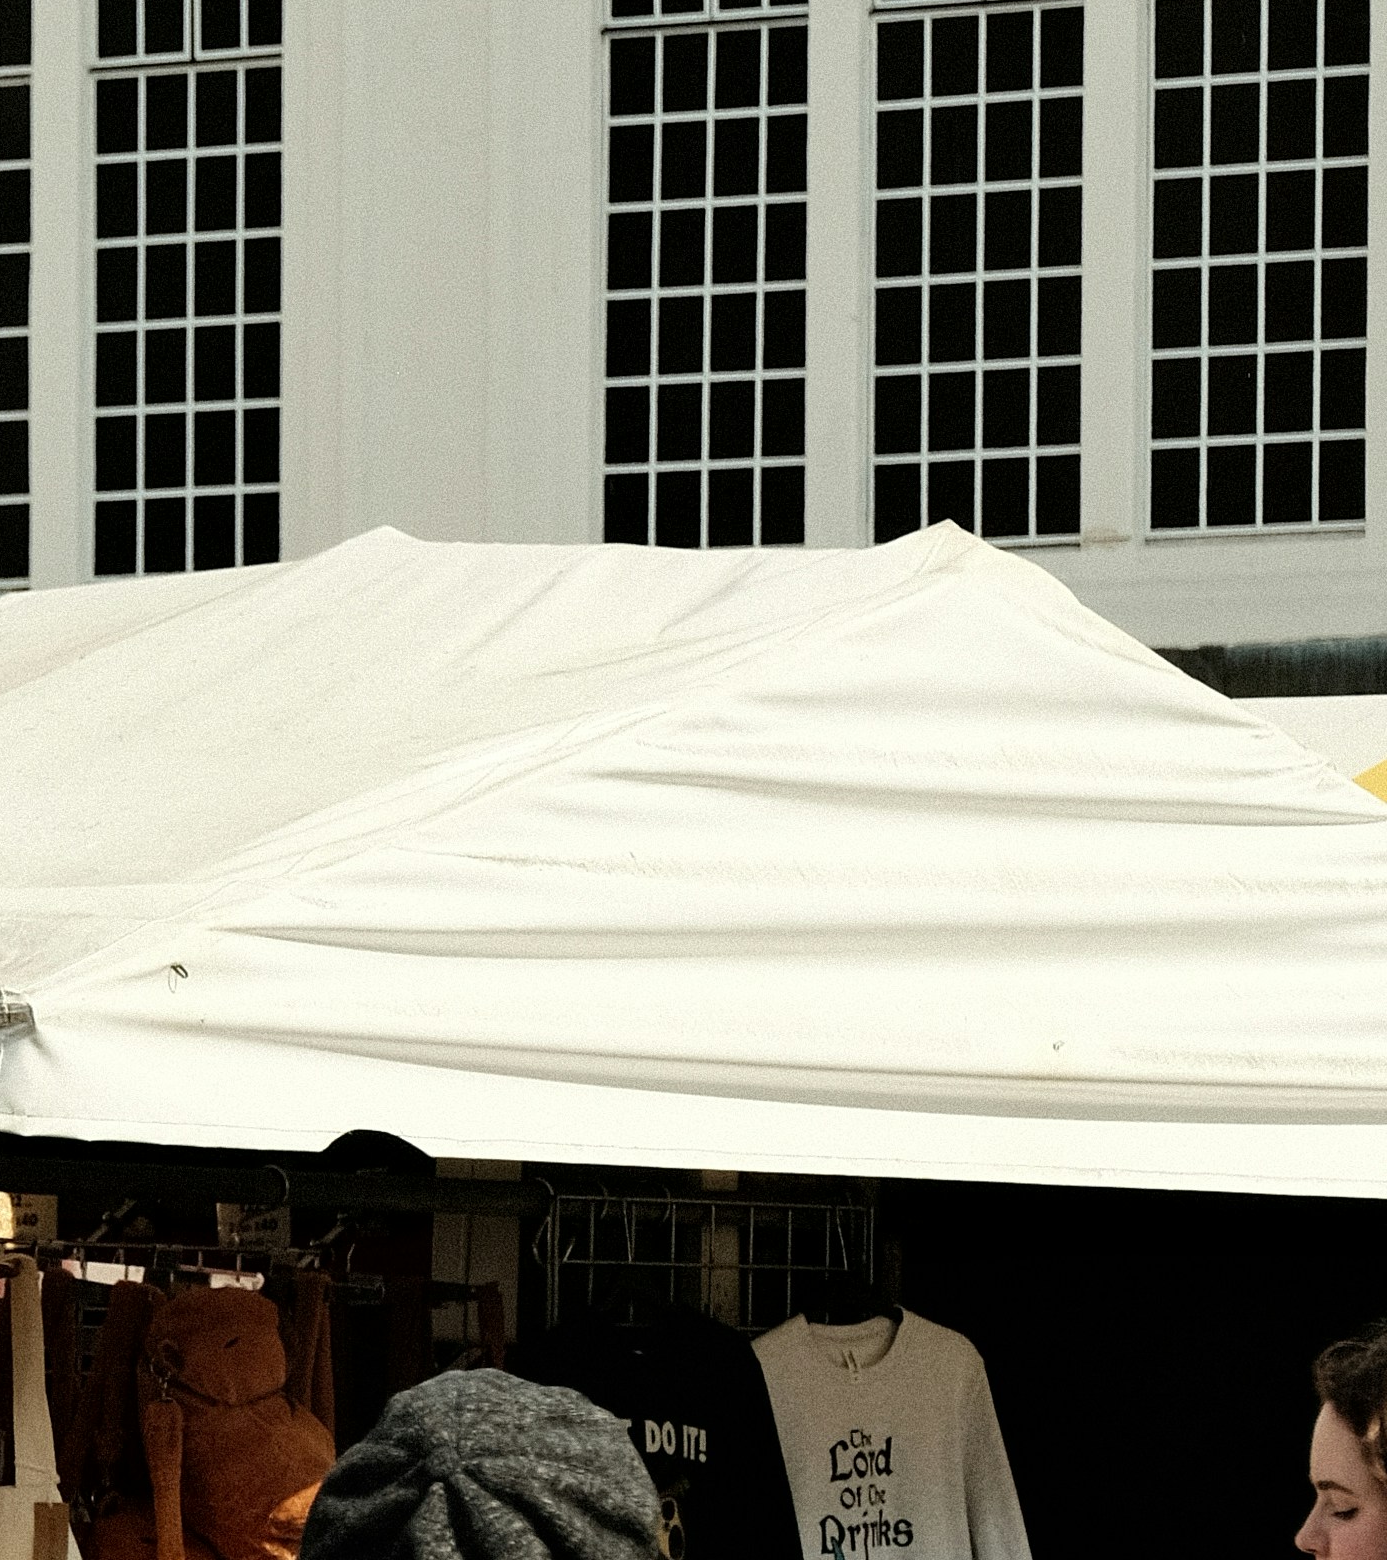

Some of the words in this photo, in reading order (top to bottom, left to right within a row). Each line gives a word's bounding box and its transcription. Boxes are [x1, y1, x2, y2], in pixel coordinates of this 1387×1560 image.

[643, 1419, 677, 1456] DO
[682, 1424, 707, 1464] IT!
[829, 1436, 893, 1482] Lord
[819, 1509, 914, 1555] Drinks
